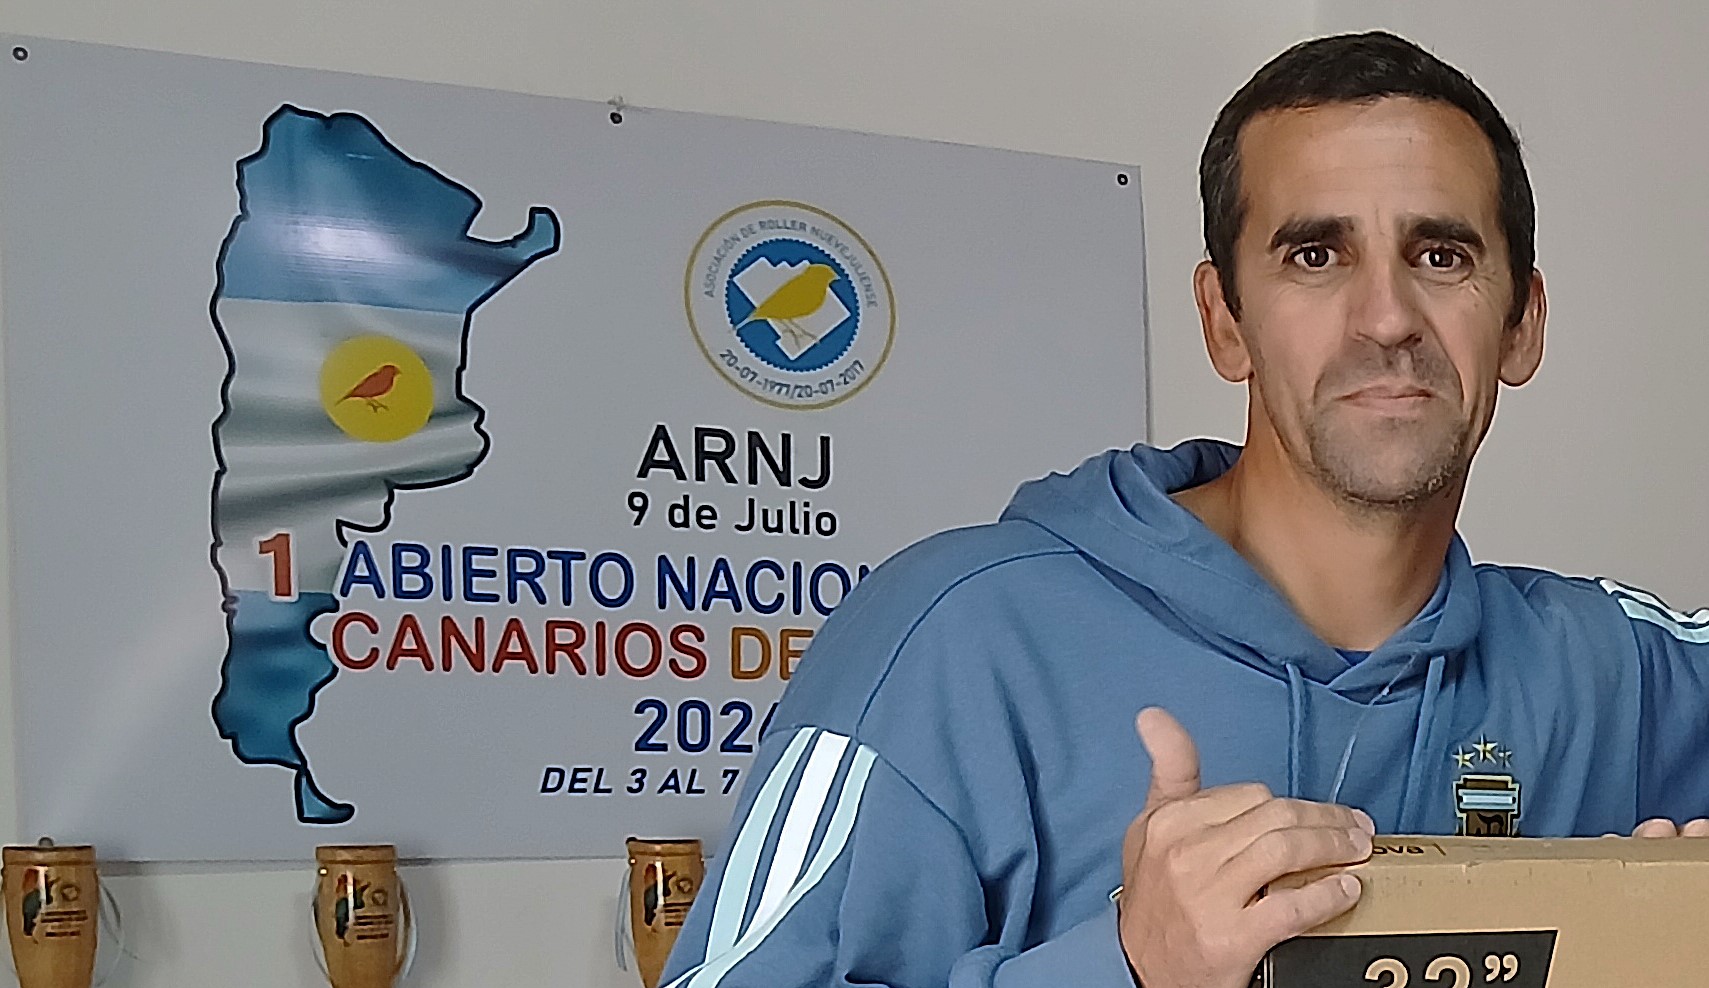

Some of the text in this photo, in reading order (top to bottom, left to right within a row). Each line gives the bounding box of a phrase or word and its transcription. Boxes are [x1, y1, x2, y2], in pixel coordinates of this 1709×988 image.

[742, 224, 757, 238] DE
[758, 219, 807, 232] ROLLER
[636, 424, 831, 489] ARNJ
[627, 491, 837, 537] 9 de Julio
[259, 533, 870, 616] 1 ABIERTO NACIO
[332, 612, 814, 680] CANARIOS DE
[540, 768, 740, 794] DEL 3 AL 7
[1372, 846, 1424, 855] ova
